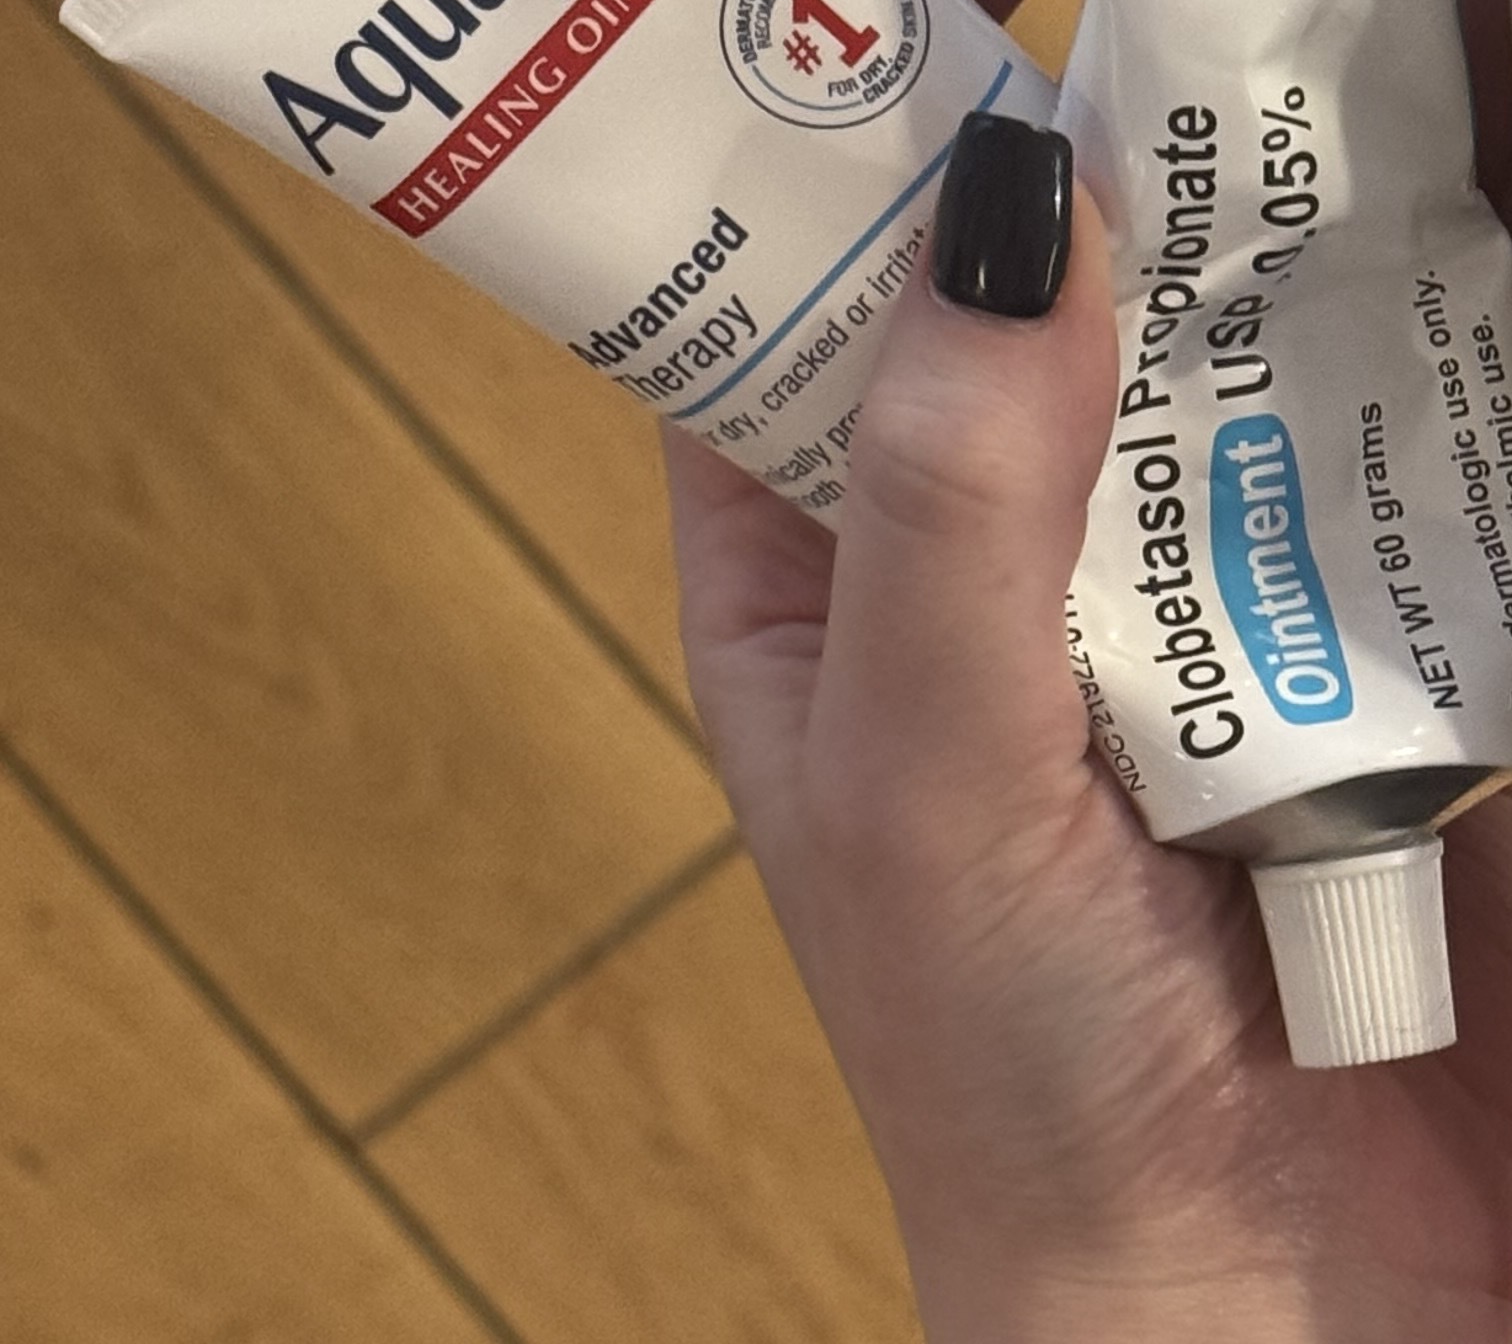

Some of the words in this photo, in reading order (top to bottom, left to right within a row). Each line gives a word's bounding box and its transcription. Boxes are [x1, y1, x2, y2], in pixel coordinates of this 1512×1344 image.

[827, 77, 859, 98] FOR
[862, 41, 915, 104] CRACKED
[398, 56, 567, 224] HEALING
[1251, 85, 1319, 276] 0.05%
[567, 206, 750, 370] Advanced
[1118, 104, 1218, 419] Propionate
[1413, 269, 1452, 349] only.
[1472, 313, 1505, 384] use.
[719, 411, 769, 441] dry,
[761, 318, 849, 413] cracked
[845, 292, 874, 327] or
[1438, 356, 1470, 421] use
[1361, 401, 1405, 522] grams
[1224, 432, 1341, 707] Ointment
[1379, 531, 1411, 574] 60
[1117, 433, 1245, 760] Clobetasol
[1388, 581, 1435, 635] WT
[1410, 642, 1463, 711] NET
[1104, 733, 1148, 793] NDC
